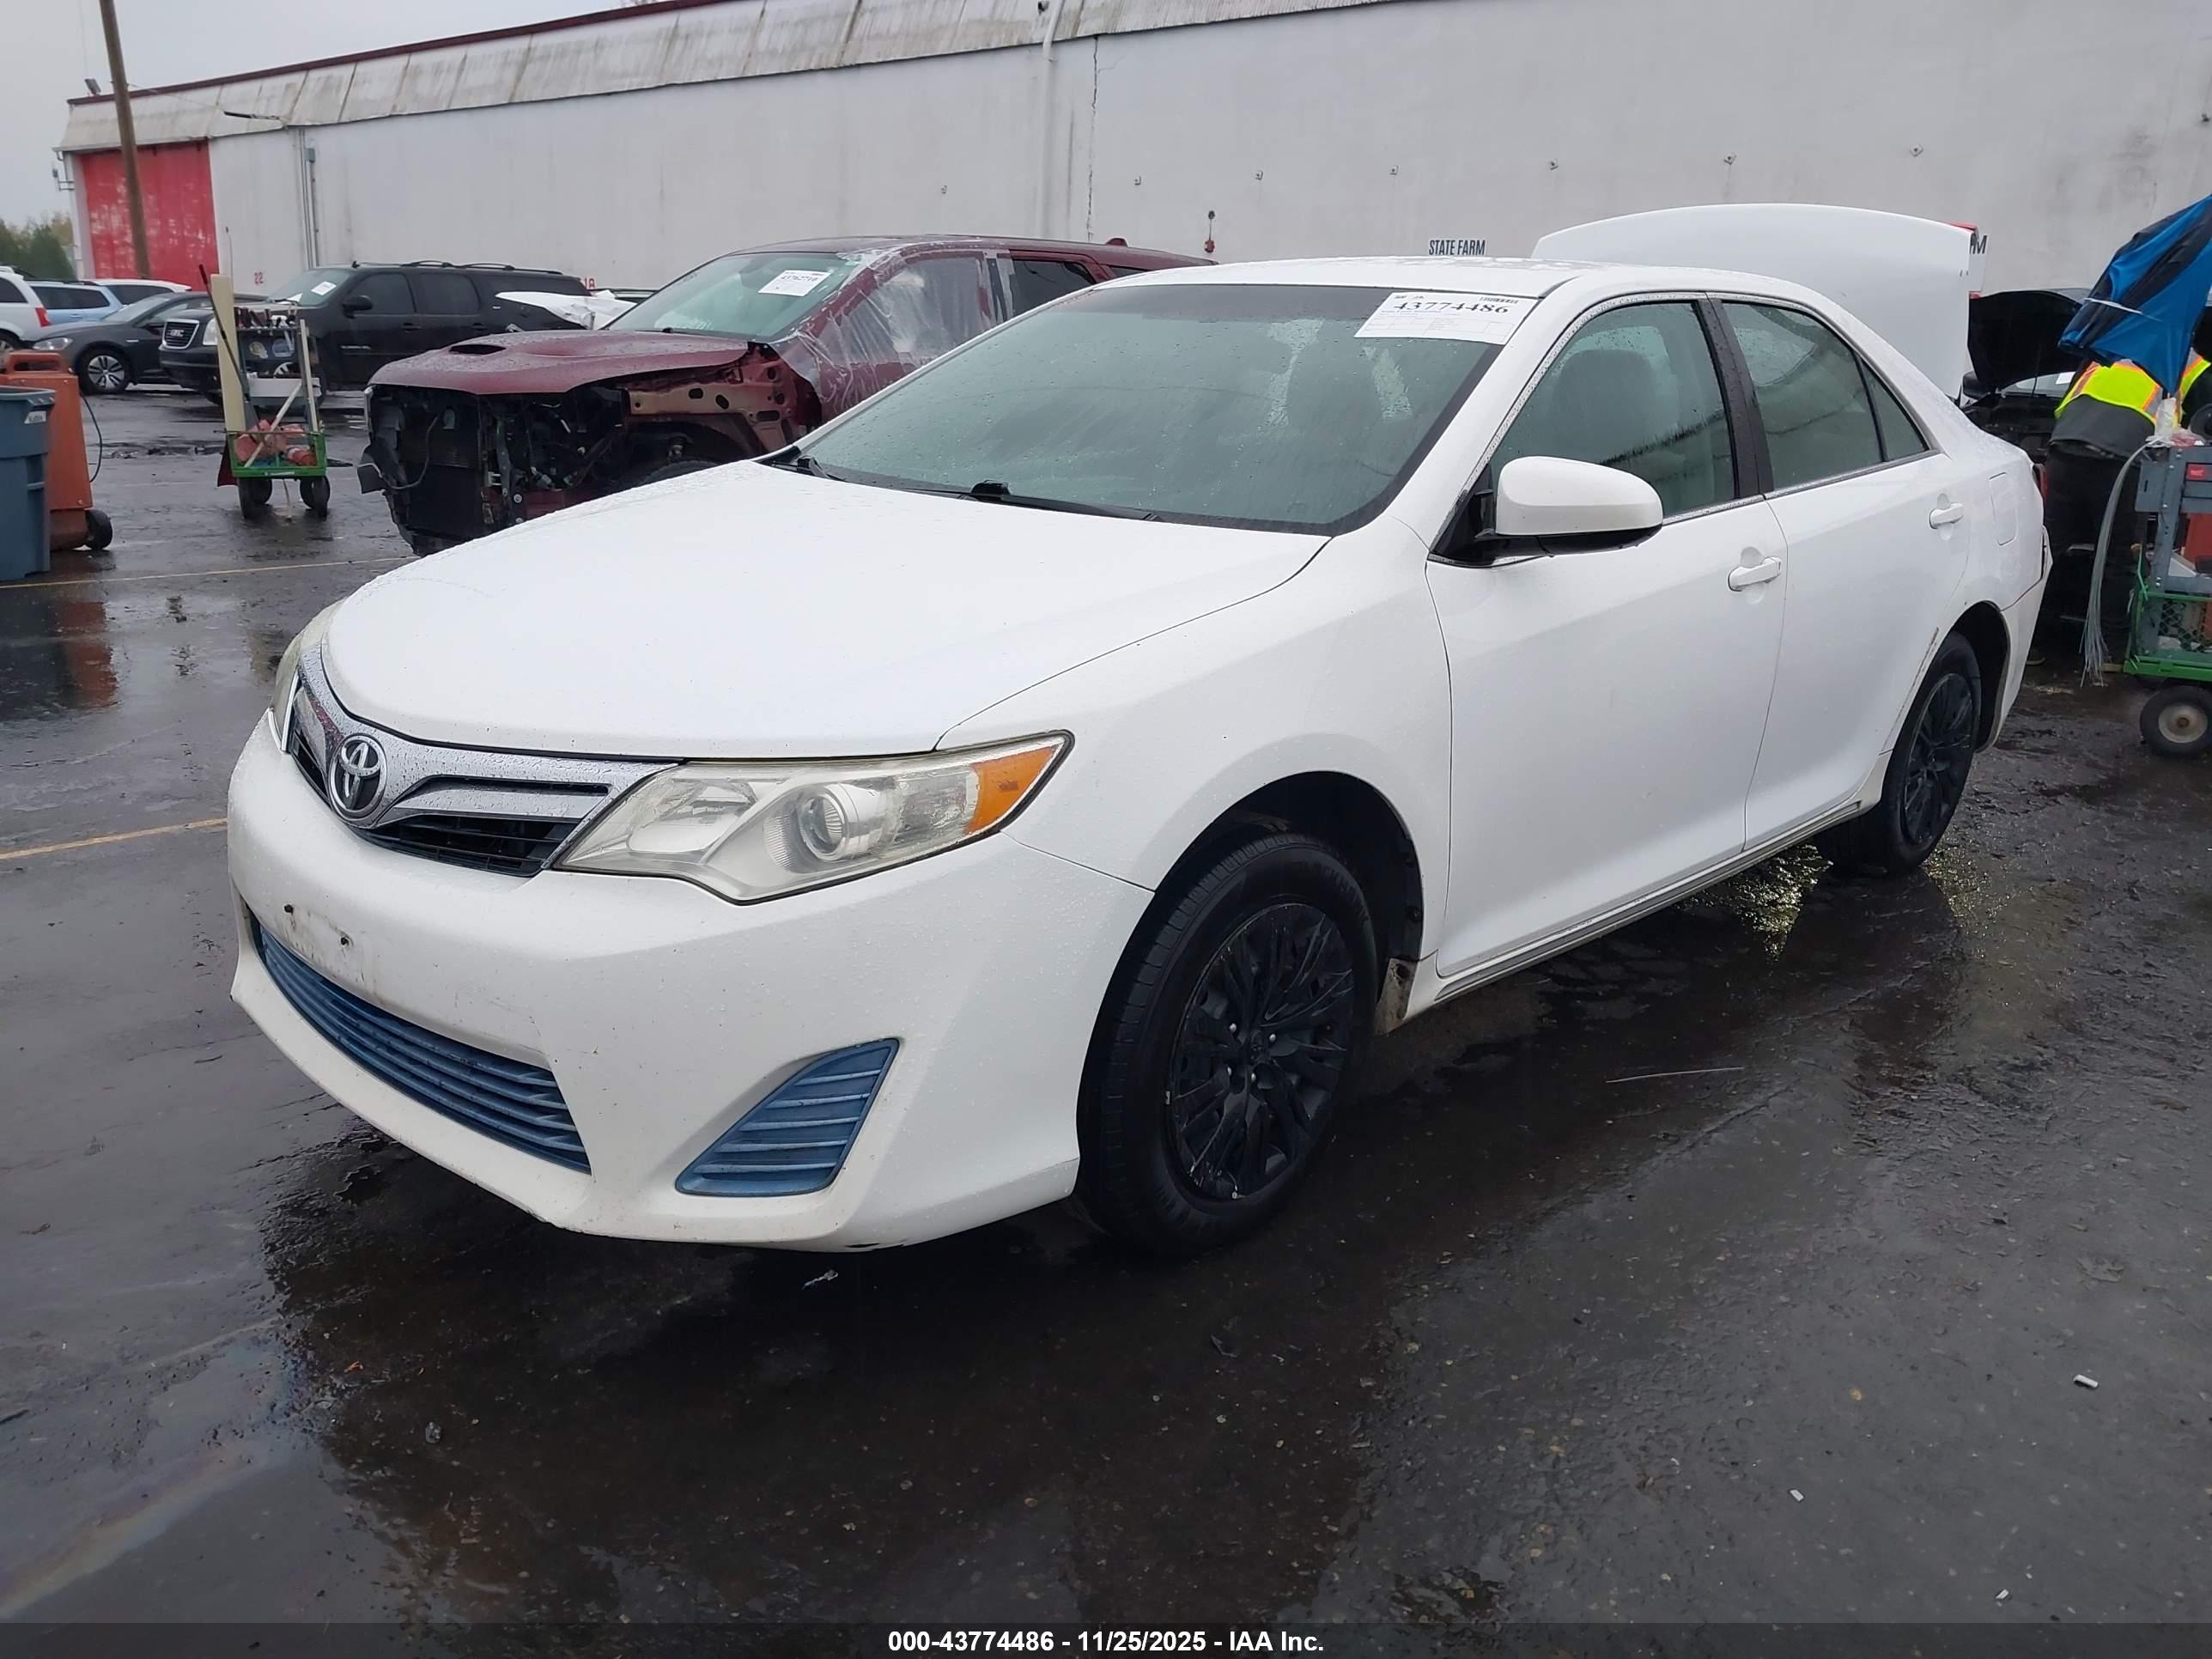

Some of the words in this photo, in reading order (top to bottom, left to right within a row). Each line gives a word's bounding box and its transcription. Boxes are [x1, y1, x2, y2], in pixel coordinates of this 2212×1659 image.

[1428, 240, 1455, 255] STATE
[1457, 240, 1486, 255] FARM
[1394, 301, 1510, 314] 43774486
